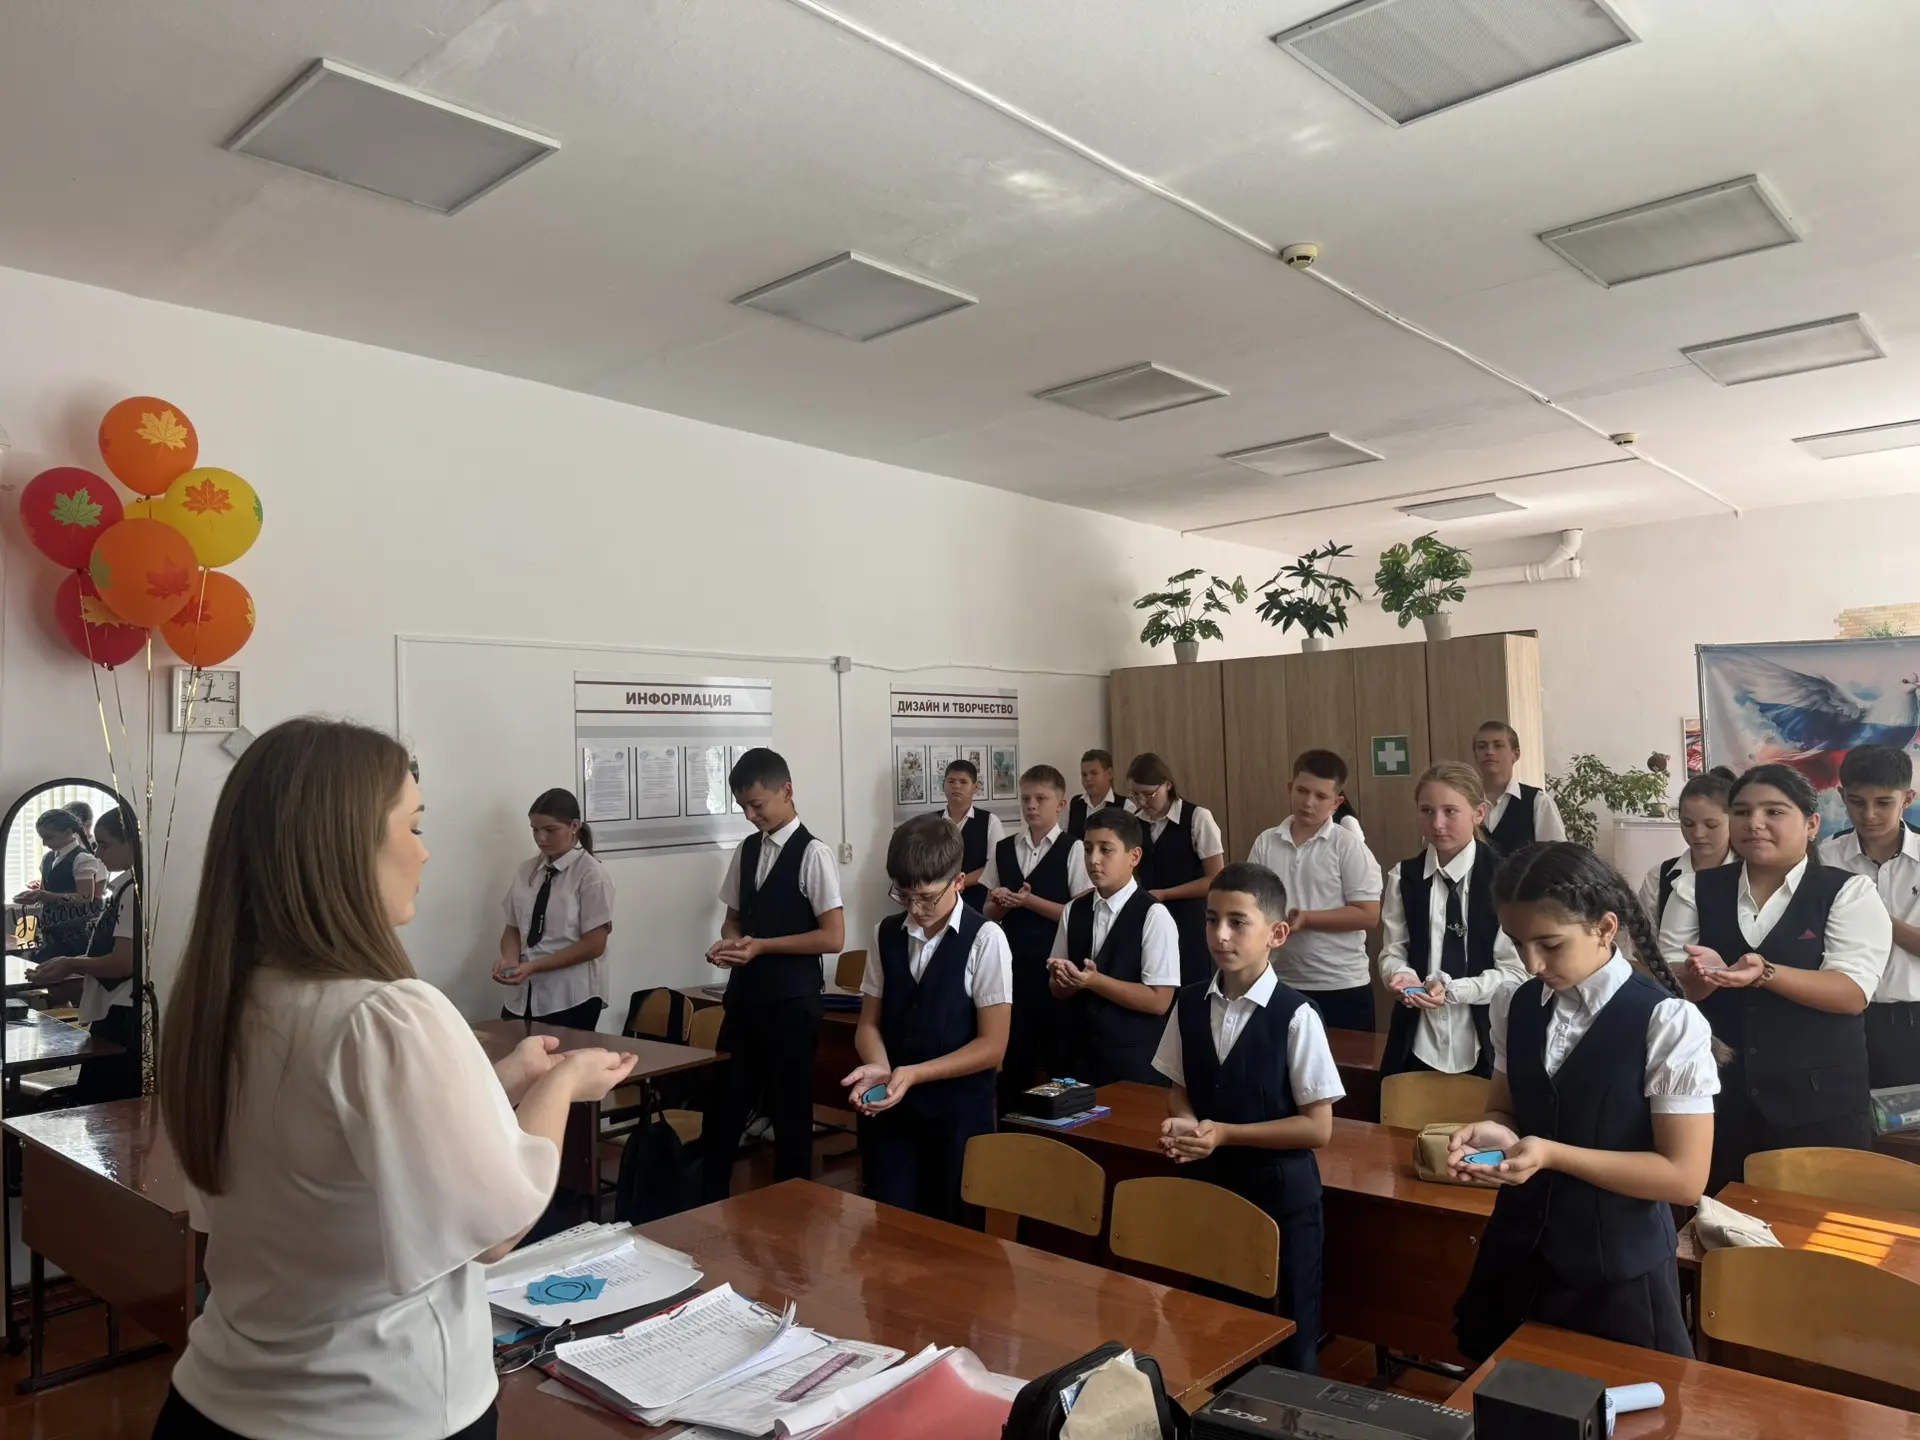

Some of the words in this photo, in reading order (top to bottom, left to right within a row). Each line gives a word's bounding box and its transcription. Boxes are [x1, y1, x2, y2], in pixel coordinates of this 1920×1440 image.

[204, 672, 214, 681] 12
[220, 673, 225, 681] 1
[228, 681, 236, 690] 2
[625, 691, 732, 708] ИНФОРМАЦИЯ
[897, 699, 940, 713] ДИЗАЙН
[942, 701, 950, 712] И
[952, 702, 1014, 714] ТВОРЧЕСТВО
[204, 717, 211, 726] 6
[218, 717, 225, 725] 5
[1212, 1407, 1268, 1423] acer
